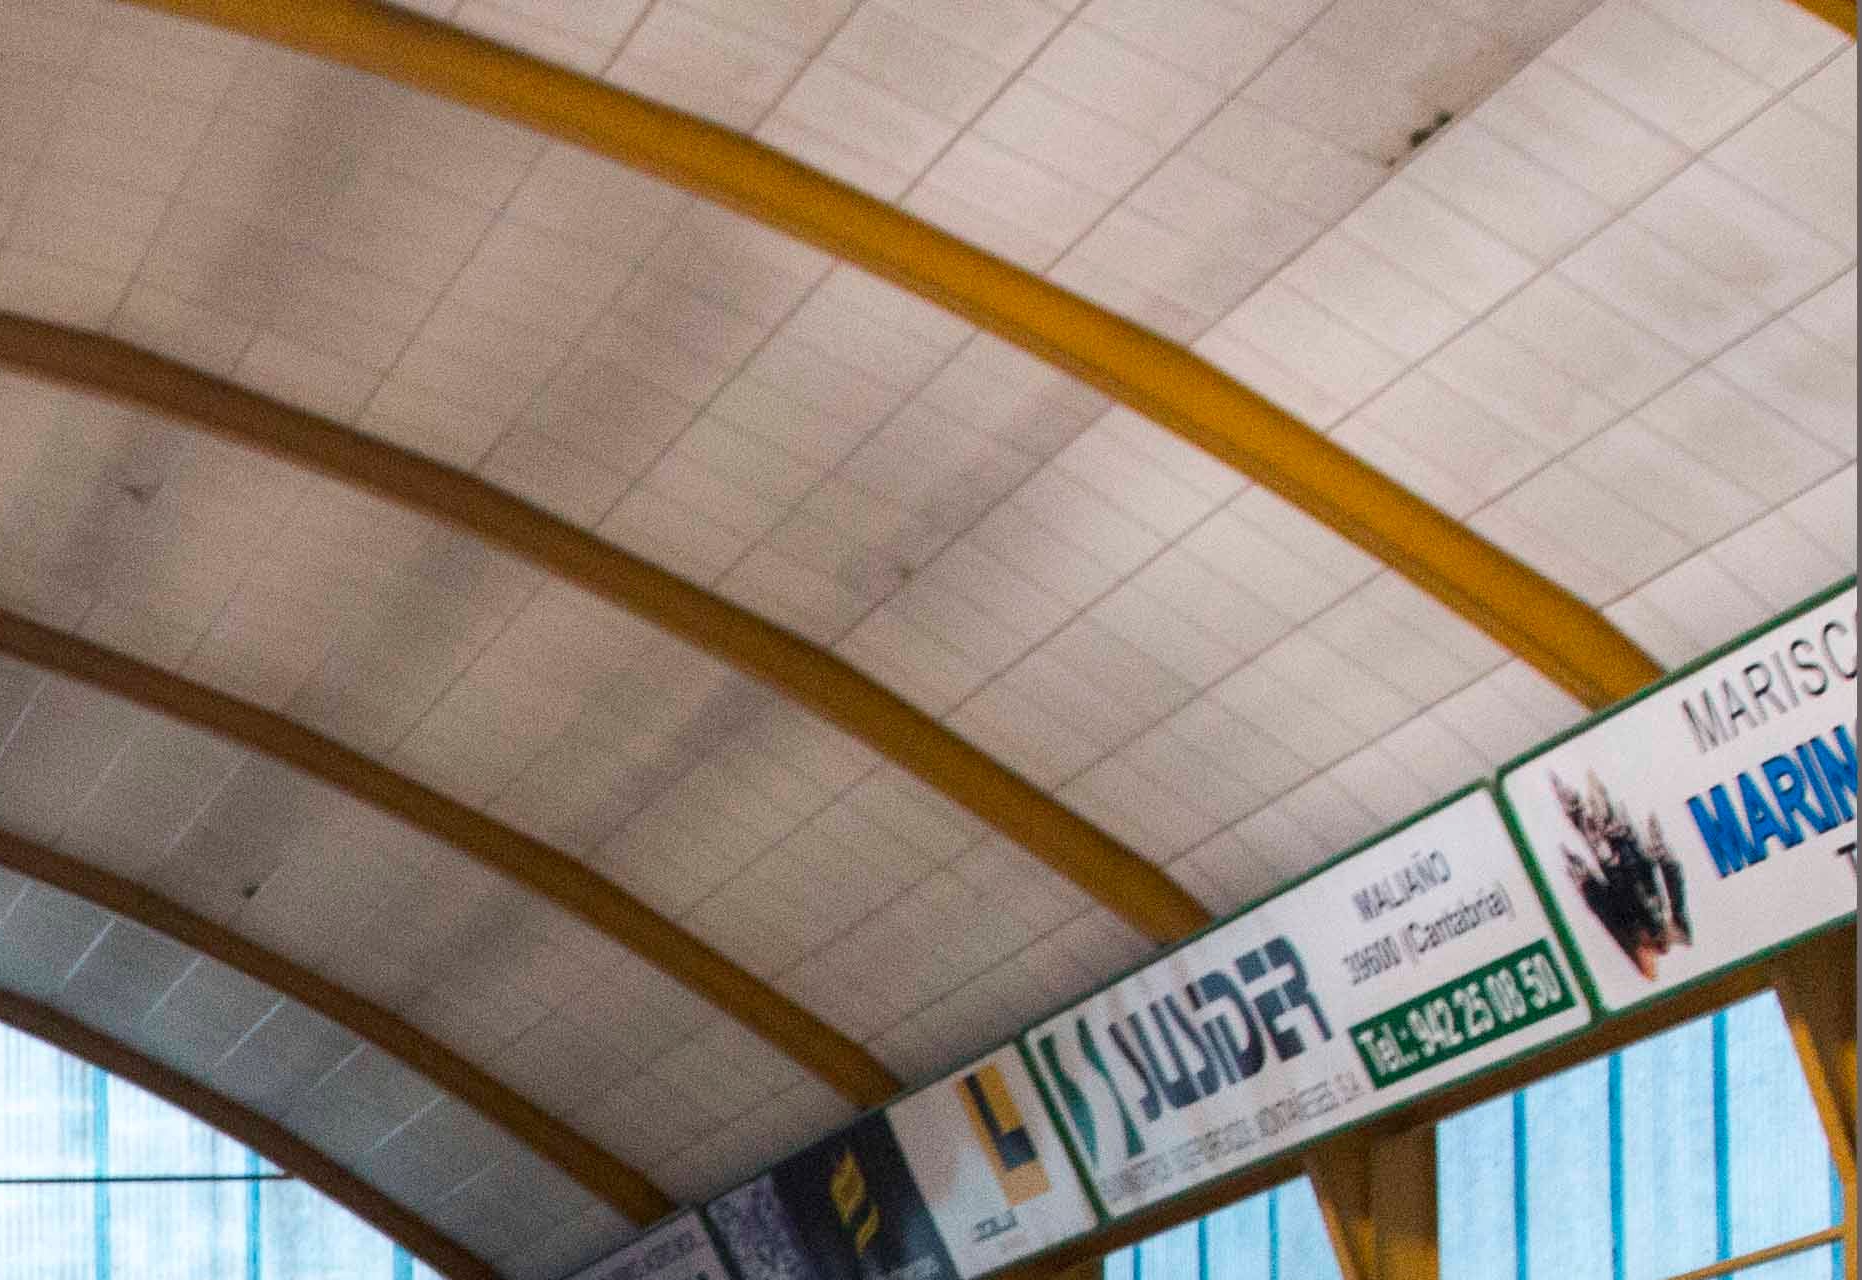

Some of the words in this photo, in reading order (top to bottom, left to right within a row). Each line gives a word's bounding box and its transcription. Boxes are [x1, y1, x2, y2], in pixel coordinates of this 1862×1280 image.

[1682, 620, 1856, 753] MARISC
[1686, 724, 1856, 879] MARIN
[1346, 938, 1402, 987] 39600
[1402, 880, 1513, 972] (Cantabria)
[1352, 847, 1450, 924] MALIAÑO
[1411, 1005, 1455, 1060] 942
[1452, 990, 1488, 1042] 25
[1525, 957, 1566, 1013] 50
